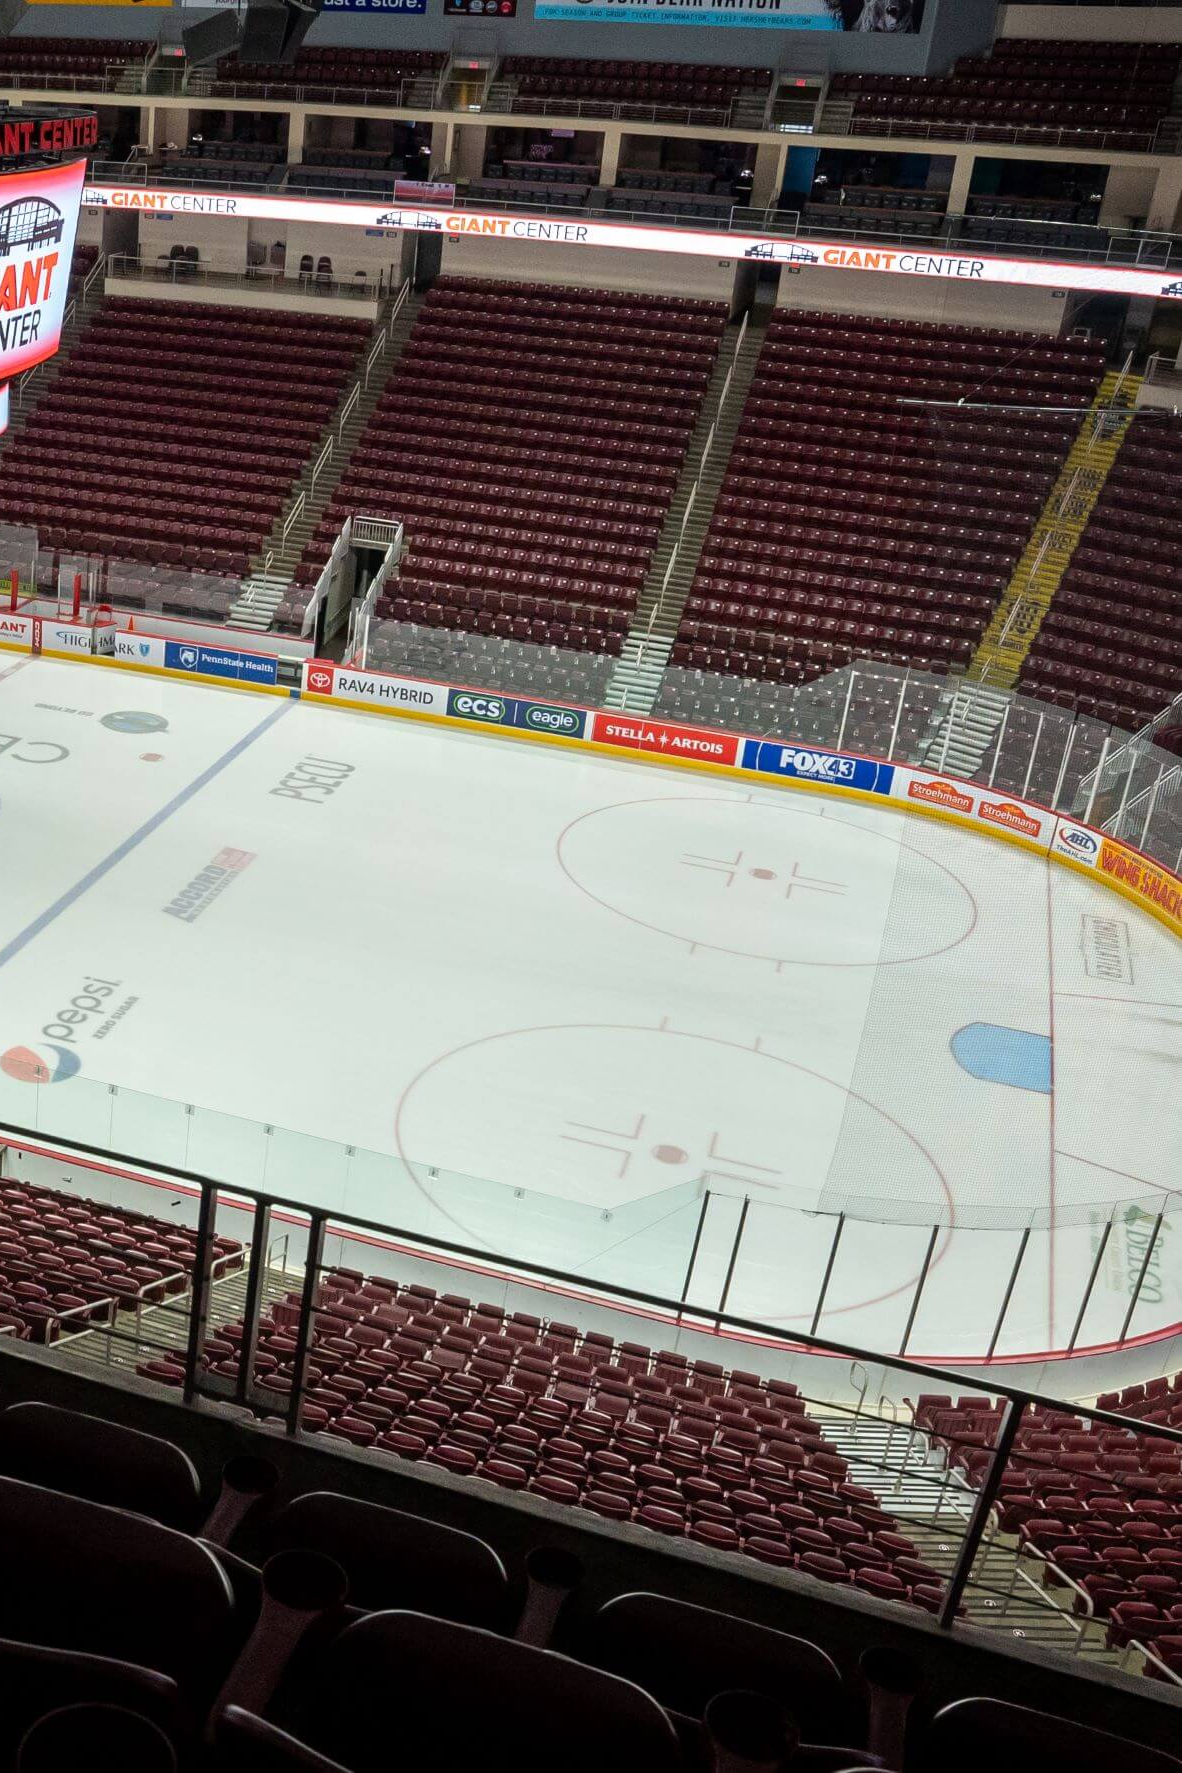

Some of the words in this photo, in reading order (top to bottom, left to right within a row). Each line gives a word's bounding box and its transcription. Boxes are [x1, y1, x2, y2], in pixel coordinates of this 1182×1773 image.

[40, 117, 99, 150] CENTER
[111, 192, 167, 209] GIANT
[171, 196, 237, 214] CENTER
[446, 216, 510, 235] GIANT
[513, 221, 588, 242] CENTER
[823, 249, 897, 269] GIANT
[899, 255, 984, 278] CENTER
[245, 661, 274, 673] Health
[338, 677, 375, 696] RAV4
[379, 685, 434, 705] HYBRID
[456, 695, 501, 718] ecs
[532, 710, 573, 729] eagle
[605, 724, 655, 742] STELLA
[671, 739, 724, 755] ARTOIS
[268, 753, 357, 805] PSECU
[912, 783, 970, 807] Stroehmann
[982, 803, 1038, 832] Stroehmann
[1102, 848, 1139, 888] WING
[161, 863, 228, 920] ACCORD
[40, 976, 122, 1044] pepsi
[113, 995, 140, 1021] SUGAR
